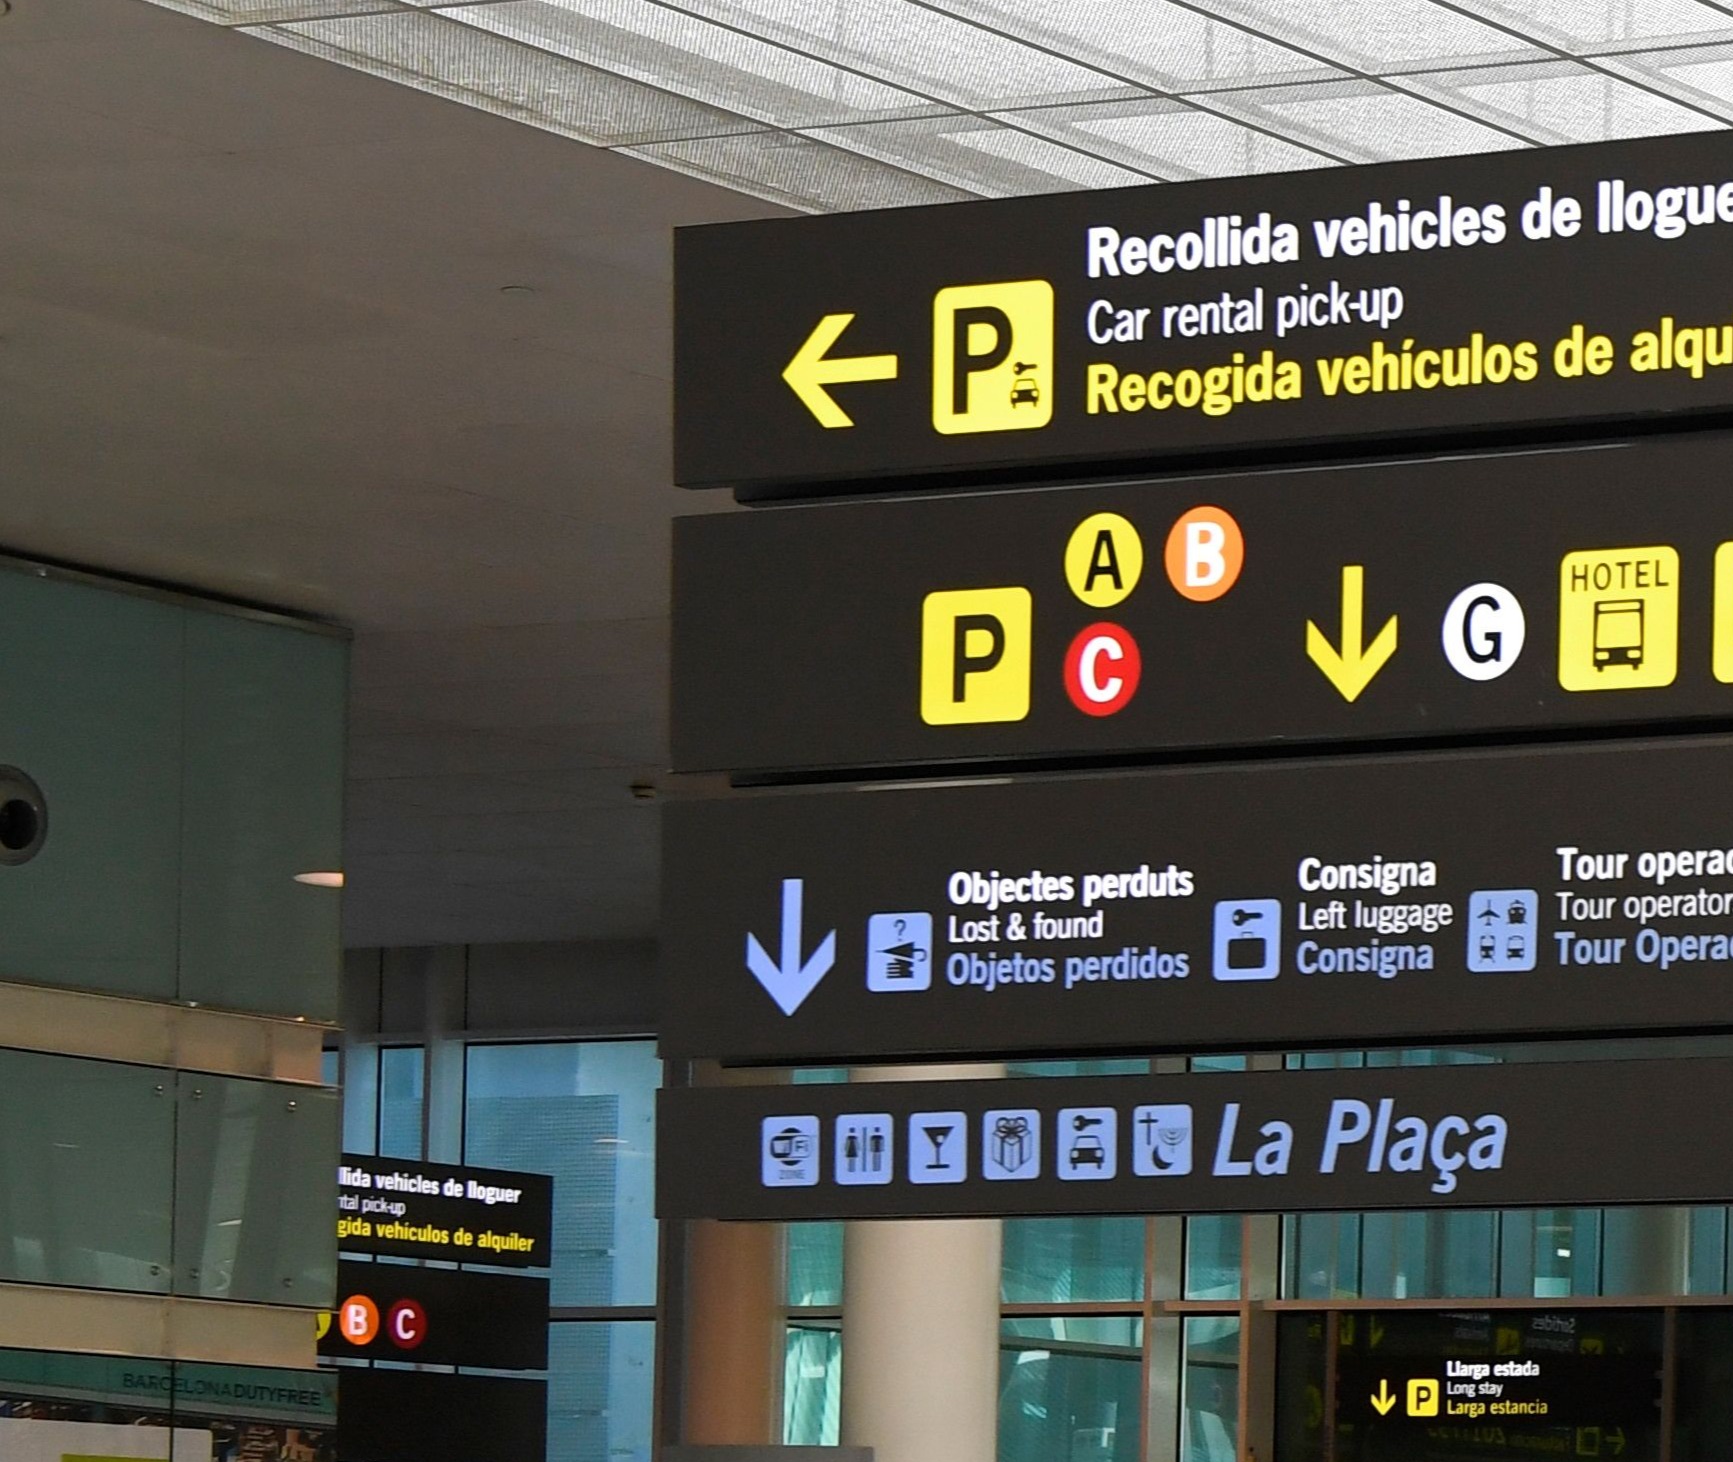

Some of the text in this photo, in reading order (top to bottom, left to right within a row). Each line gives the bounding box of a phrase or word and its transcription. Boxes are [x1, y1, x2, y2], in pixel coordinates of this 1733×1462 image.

[1086, 212, 1299, 277] Recollida
[1312, 196, 1507, 258] vehicles
[1520, 187, 1582, 240] de
[1087, 280, 1404, 345] Car rental pick-up
[952, 304, 1014, 416] P
[1086, 350, 1302, 415] Recogida
[1316, 332, 1538, 398] vehículos
[1553, 324, 1614, 376] de
[1081, 522, 1224, 593] A B
[952, 613, 1002, 704] P
[1461, 595, 1503, 663] G
[1569, 559, 1669, 592] HOTEL
[1077, 636, 1125, 704] C
[1298, 855, 1438, 896] Consigna
[1555, 846, 1629, 882] Tour
[948, 864, 1195, 911] Objectes perduts
[1555, 891, 1616, 921] Tour
[948, 910, 1104, 944] Lost & found
[1298, 898, 1454, 934] Left luggage
[1296, 939, 1435, 980] Consigna
[1553, 930, 1627, 966] Tour
[946, 946, 1190, 992] Objetos perdidos
[1211, 1097, 1509, 1195] La Plaça
[361, 1195, 408, 1218] pick-up
[374, 1172, 523, 1205] vehicles de lloguer
[375, 1220, 450, 1245] vehículos
[453, 1227, 475, 1247] de
[476, 1230, 536, 1254] alquiler
[348, 1305, 417, 1340] B C
[1446, 1359, 1540, 1379] Llarga estada
[1415, 1386, 1549, 1418] P Larga estancia
[1446, 1381, 1504, 1398] Long stay
